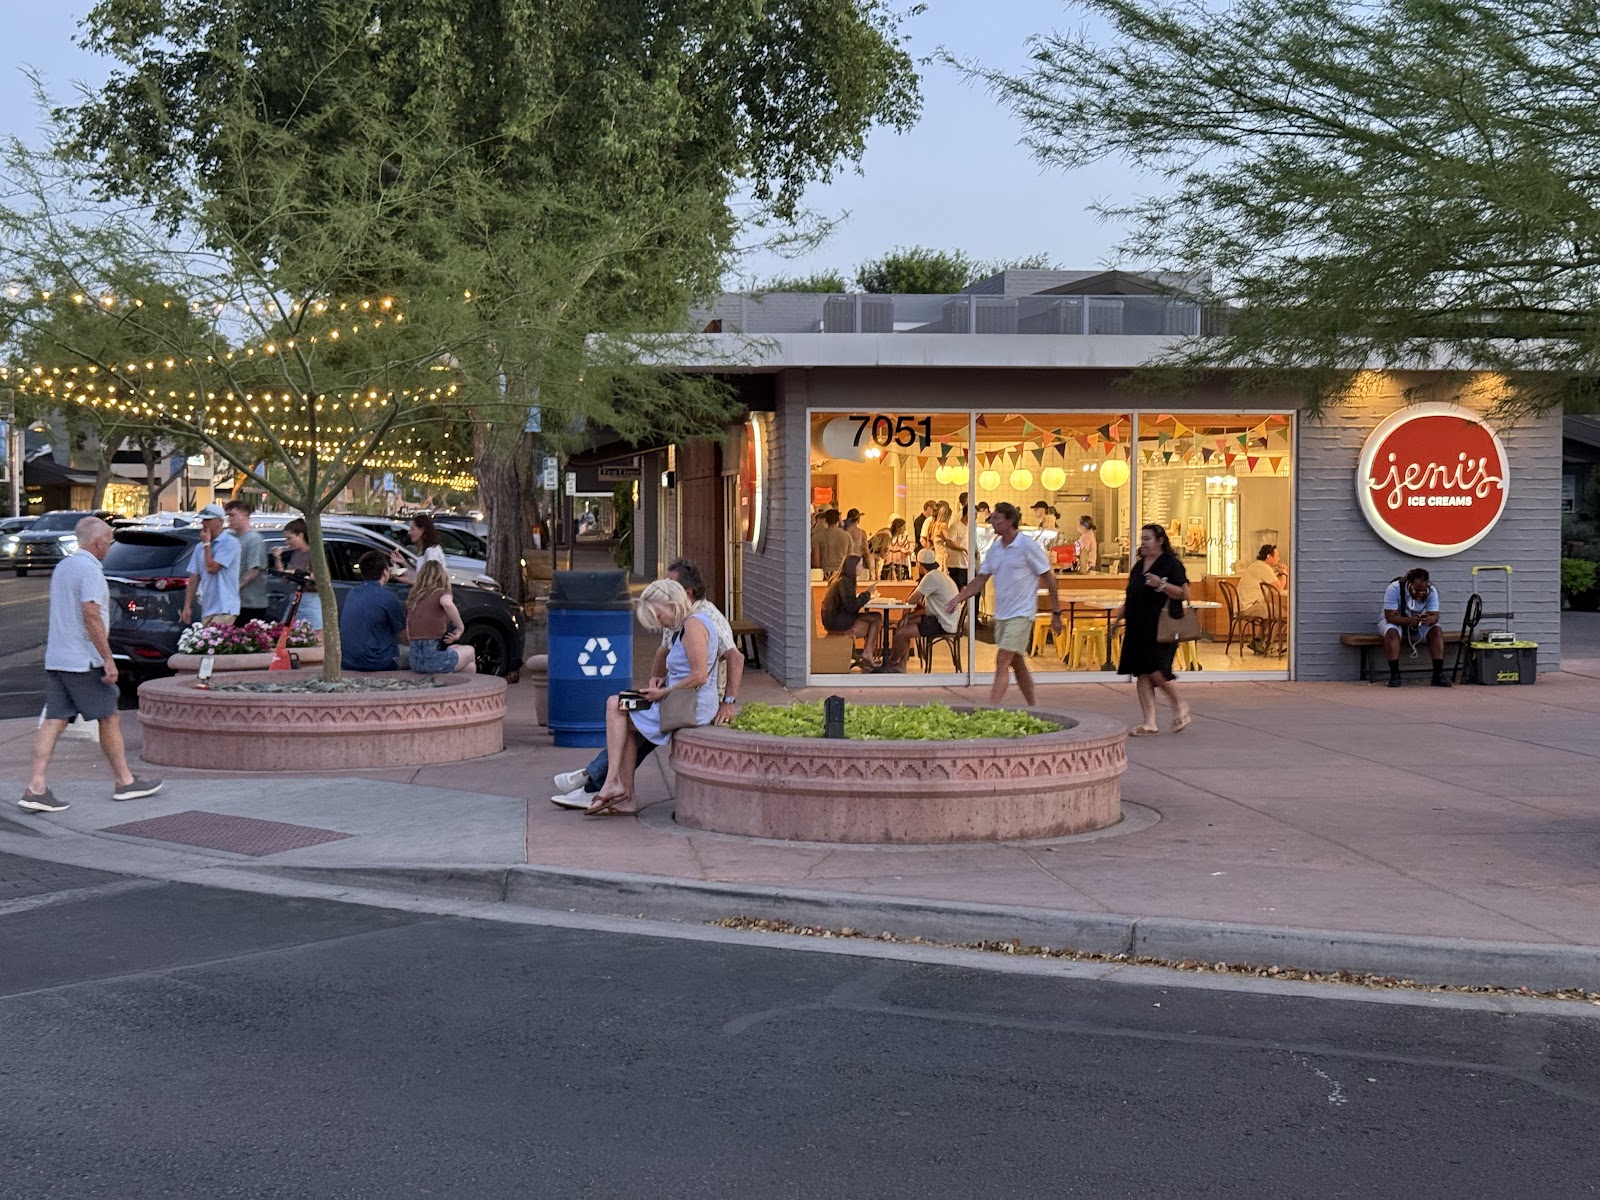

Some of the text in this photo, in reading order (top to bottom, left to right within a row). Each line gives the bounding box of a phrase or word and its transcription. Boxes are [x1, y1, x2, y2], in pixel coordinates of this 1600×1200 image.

[849, 415, 931, 447] 7051
[1369, 452, 1503, 510] jeni's
[1408, 496, 1473, 507] ICE CREAMS
